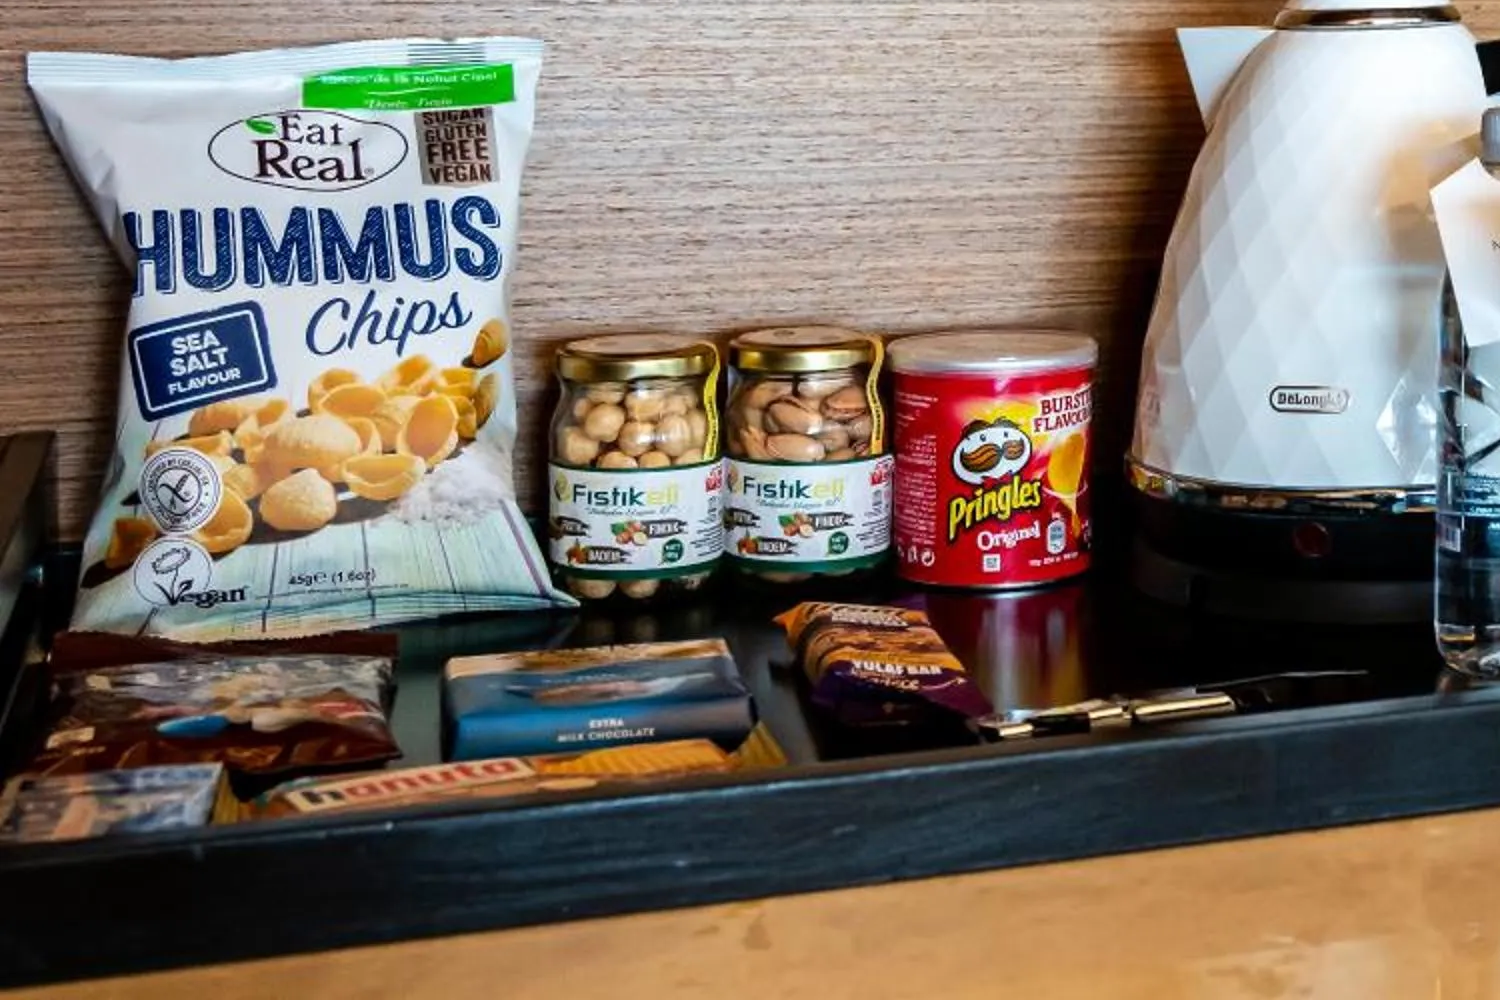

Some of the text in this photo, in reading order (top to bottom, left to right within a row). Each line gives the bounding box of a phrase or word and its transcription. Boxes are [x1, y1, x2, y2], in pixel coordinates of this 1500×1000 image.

[278, 113, 345, 147] Eat
[422, 107, 486, 126] SUGAR
[424, 123, 488, 144] GLUTEN
[254, 138, 368, 184] Real
[426, 138, 490, 164] FREE
[429, 163, 493, 185] VEGAN
[122, 195, 503, 297] HUMMUS
[305, 288, 473, 358] Chips
[171, 329, 221, 357] SEA
[169, 346, 230, 378] SALT
[168, 367, 242, 396] FLAVOUR
[948, 475, 1042, 541] Pringles
[976, 520, 1041, 551] Original
[155, 580, 247, 608] Vegan
[851, 659, 943, 676] YULAF BAR
[556, 726, 656, 744] MILK CHOCOLATE
[588, 717, 625, 730] EXTRA
